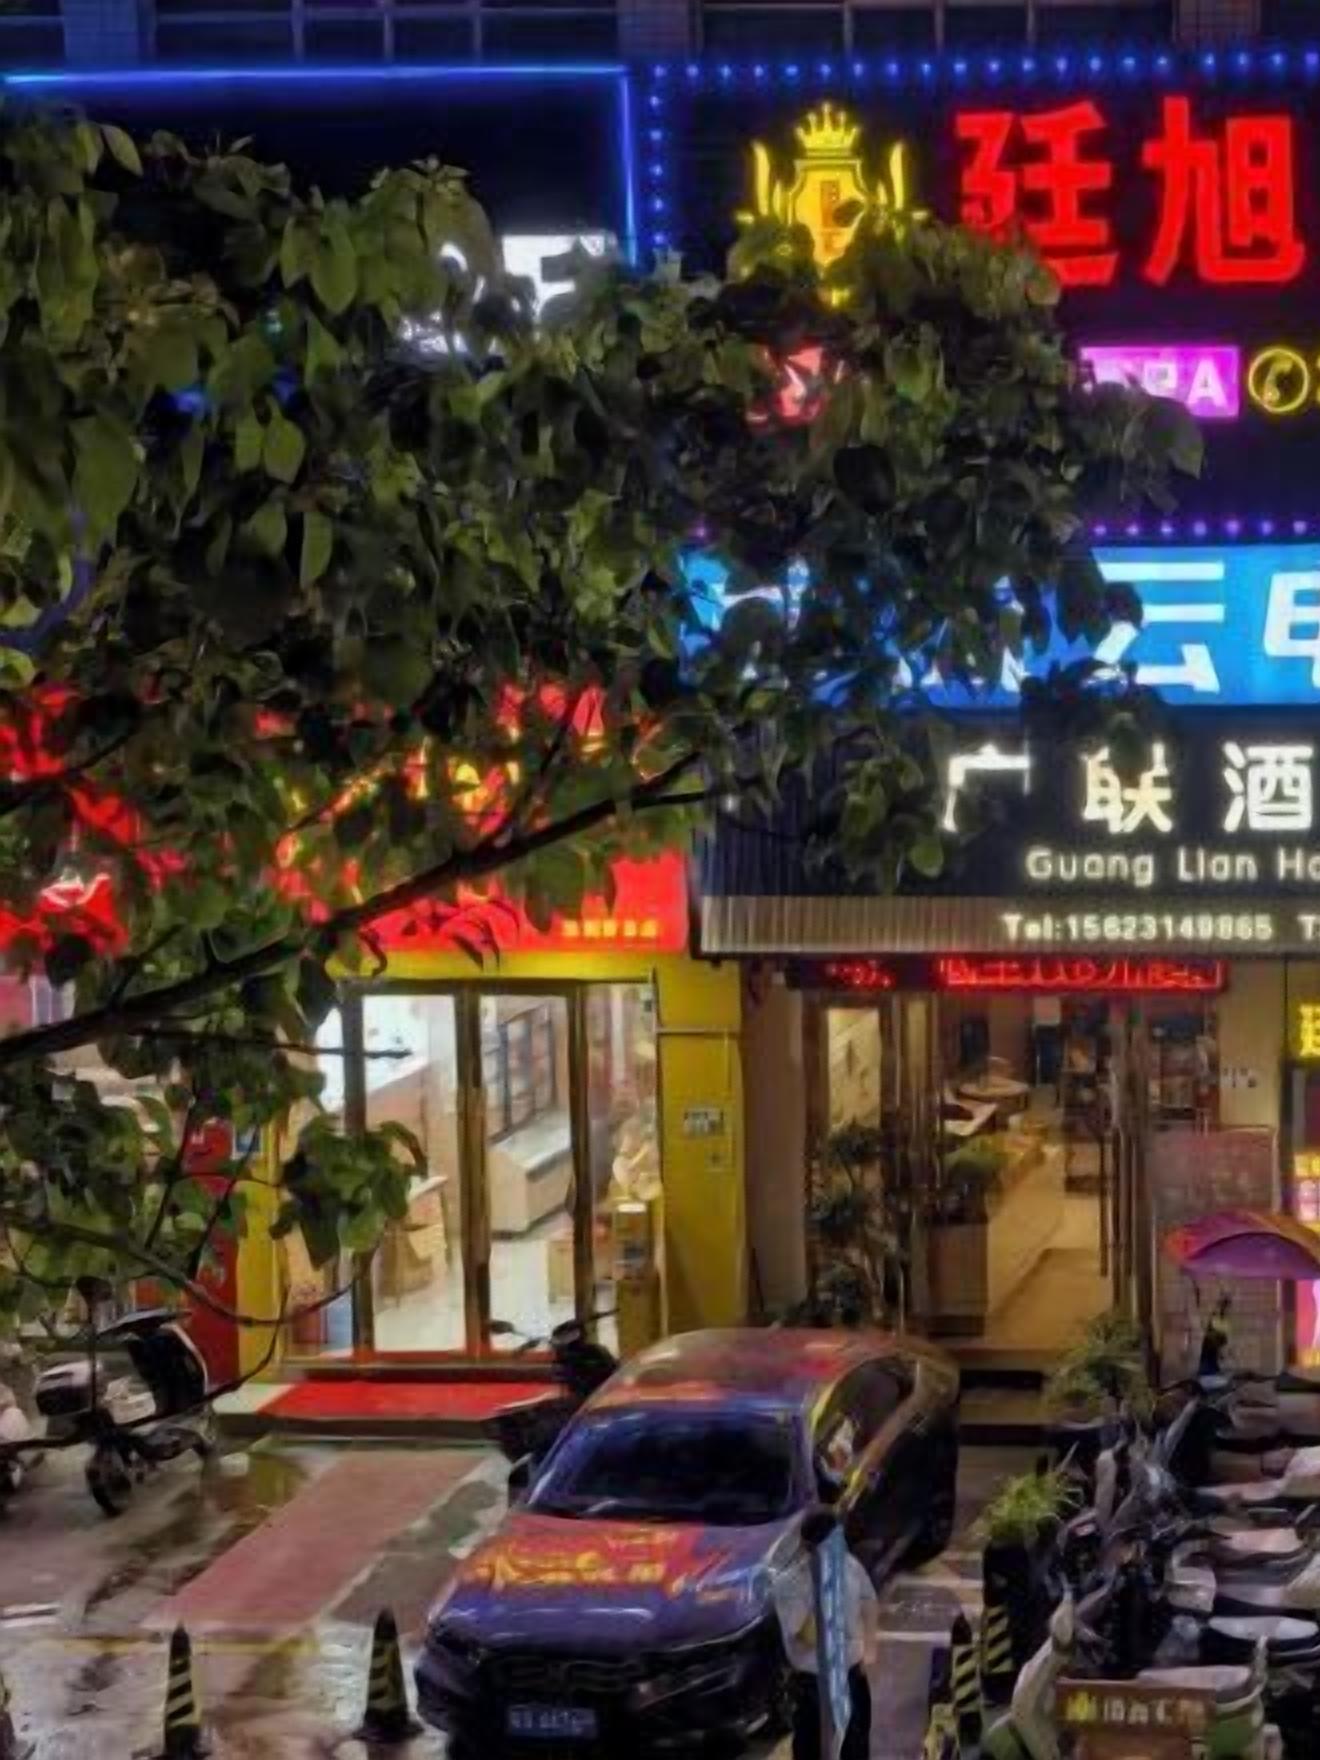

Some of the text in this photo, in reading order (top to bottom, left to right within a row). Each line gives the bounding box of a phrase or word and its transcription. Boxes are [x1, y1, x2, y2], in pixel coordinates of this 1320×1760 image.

[1088, 358, 1229, 408] PA
[1025, 844, 1154, 888] Guang
[1176, 847, 1258, 880] Lian
